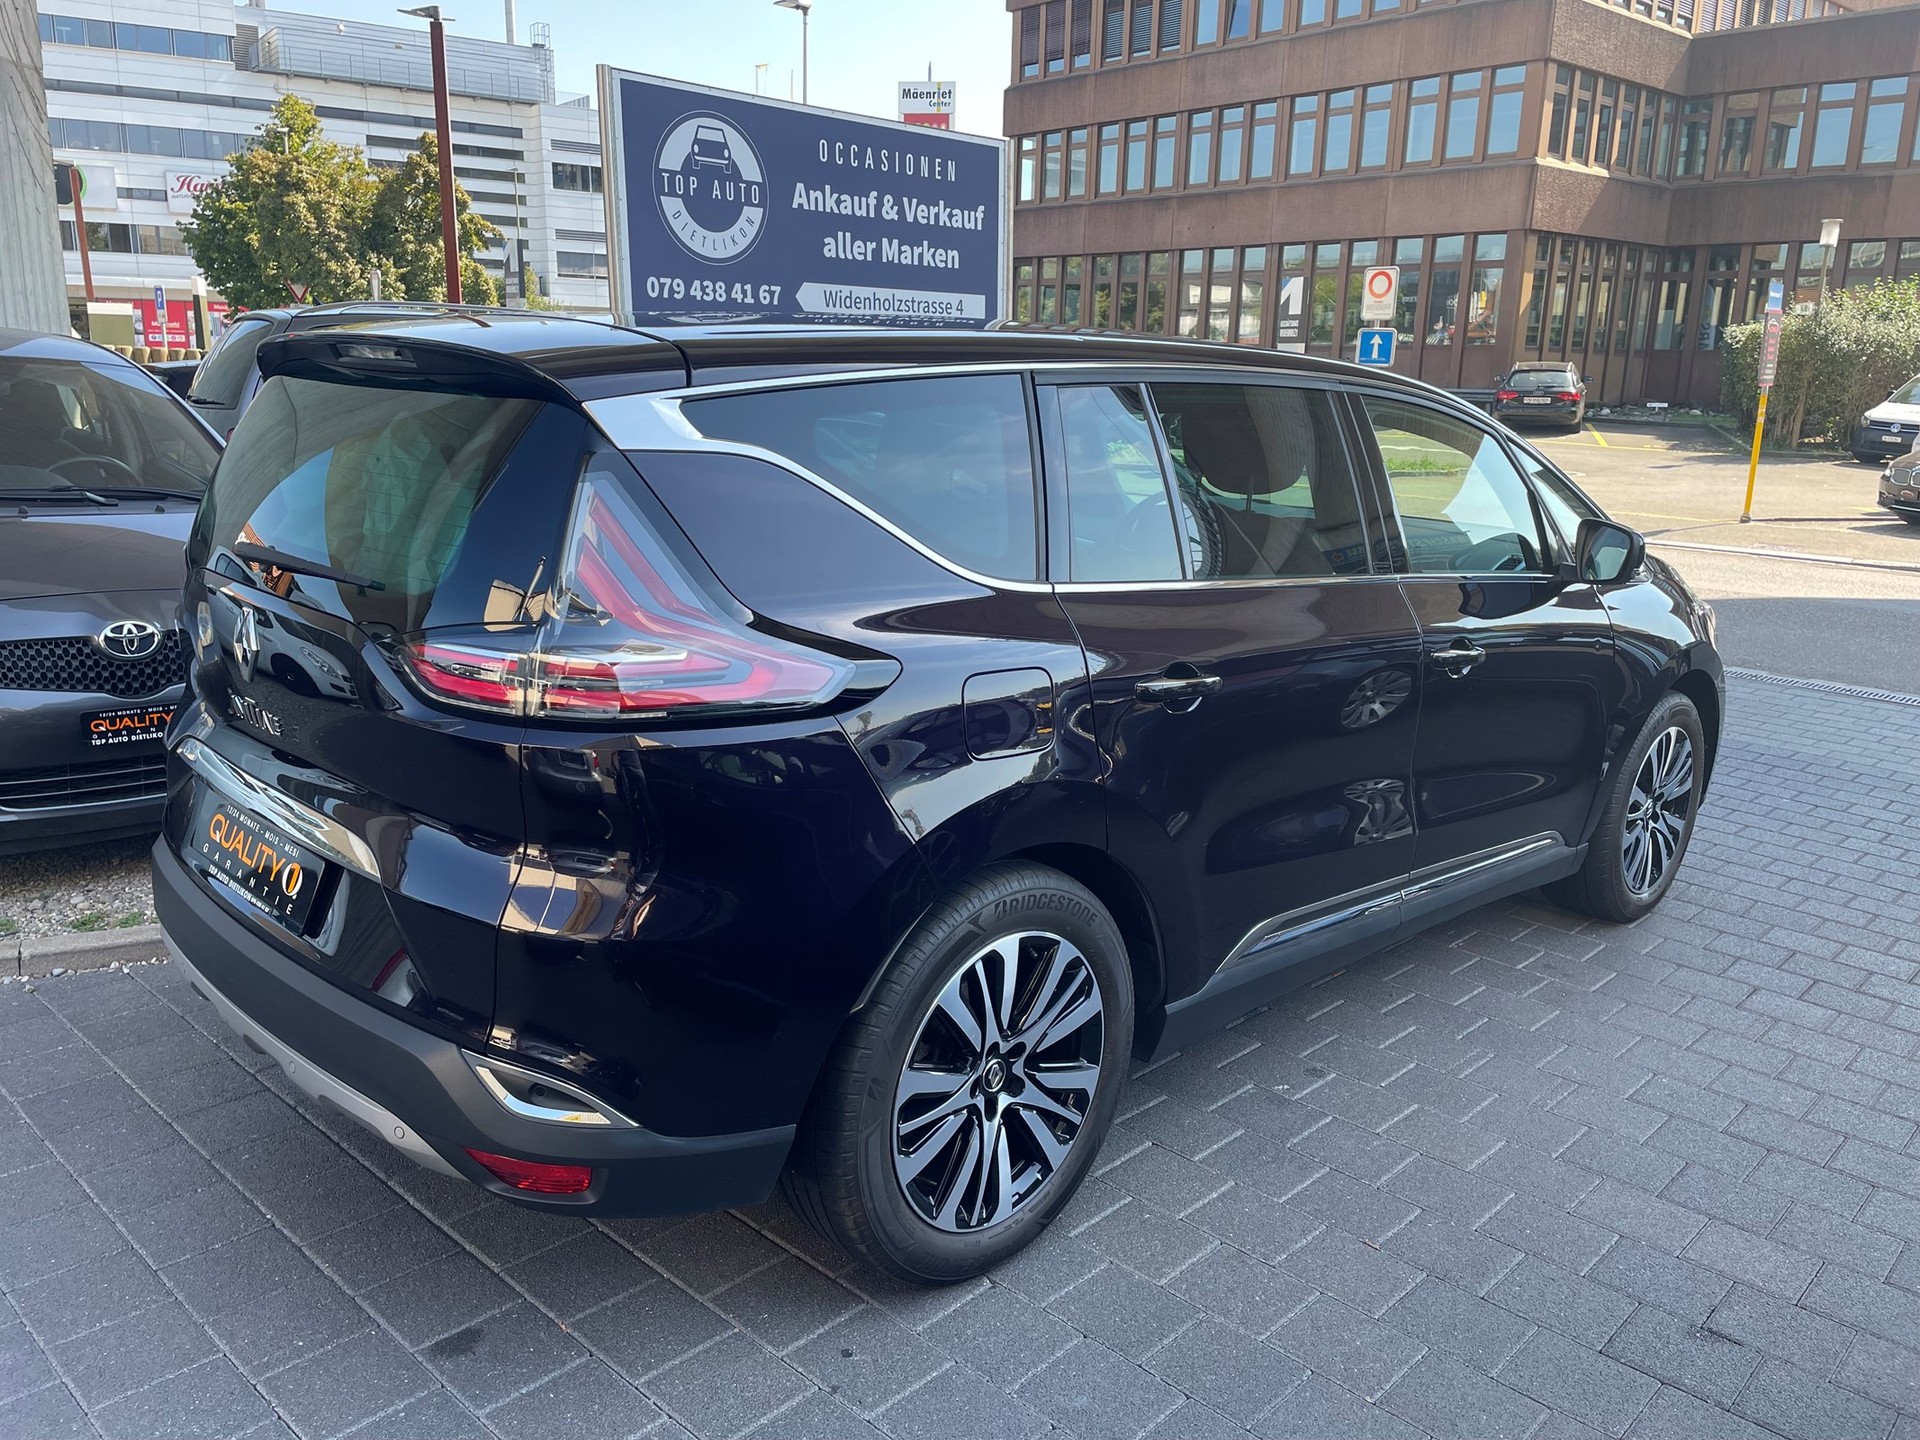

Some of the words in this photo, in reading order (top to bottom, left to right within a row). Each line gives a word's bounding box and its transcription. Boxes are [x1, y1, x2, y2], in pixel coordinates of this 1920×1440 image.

[902, 87, 953, 99] Mäenriet
[818, 139, 956, 182] OCCASIONEN
[661, 173, 698, 196] TOP
[712, 179, 760, 204] AUTO
[792, 182, 877, 218] Ankauf
[881, 194, 899, 221] &
[902, 197, 985, 230] Verkauf
[672, 210, 755, 251] DIETLIKON
[823, 231, 877, 261] aller
[881, 237, 960, 269] Marken
[646, 276, 685, 299] 079
[690, 280, 727, 302] 438
[731, 283, 755, 304] 41
[759, 284, 781, 306] 67
[823, 289, 953, 315] Widenholzstrasse
[955, 299, 964, 315] 4
[90, 712, 174, 733] QUALITY
[117, 708, 141, 716] MONATE
[91, 738, 106, 746] TOP
[108, 735, 128, 744] AUTO
[131, 731, 164, 741] DIETLIKO
[92, 727, 156, 739] GARAN
[209, 813, 286, 882] QUALITY
[239, 813, 260, 833] MONATE
[264, 829, 279, 845] MOIS
[283, 842, 300, 858] MESI
[202, 843, 293, 915] GARANTIE
[993, 893, 1098, 927] BRIDGESTONE
